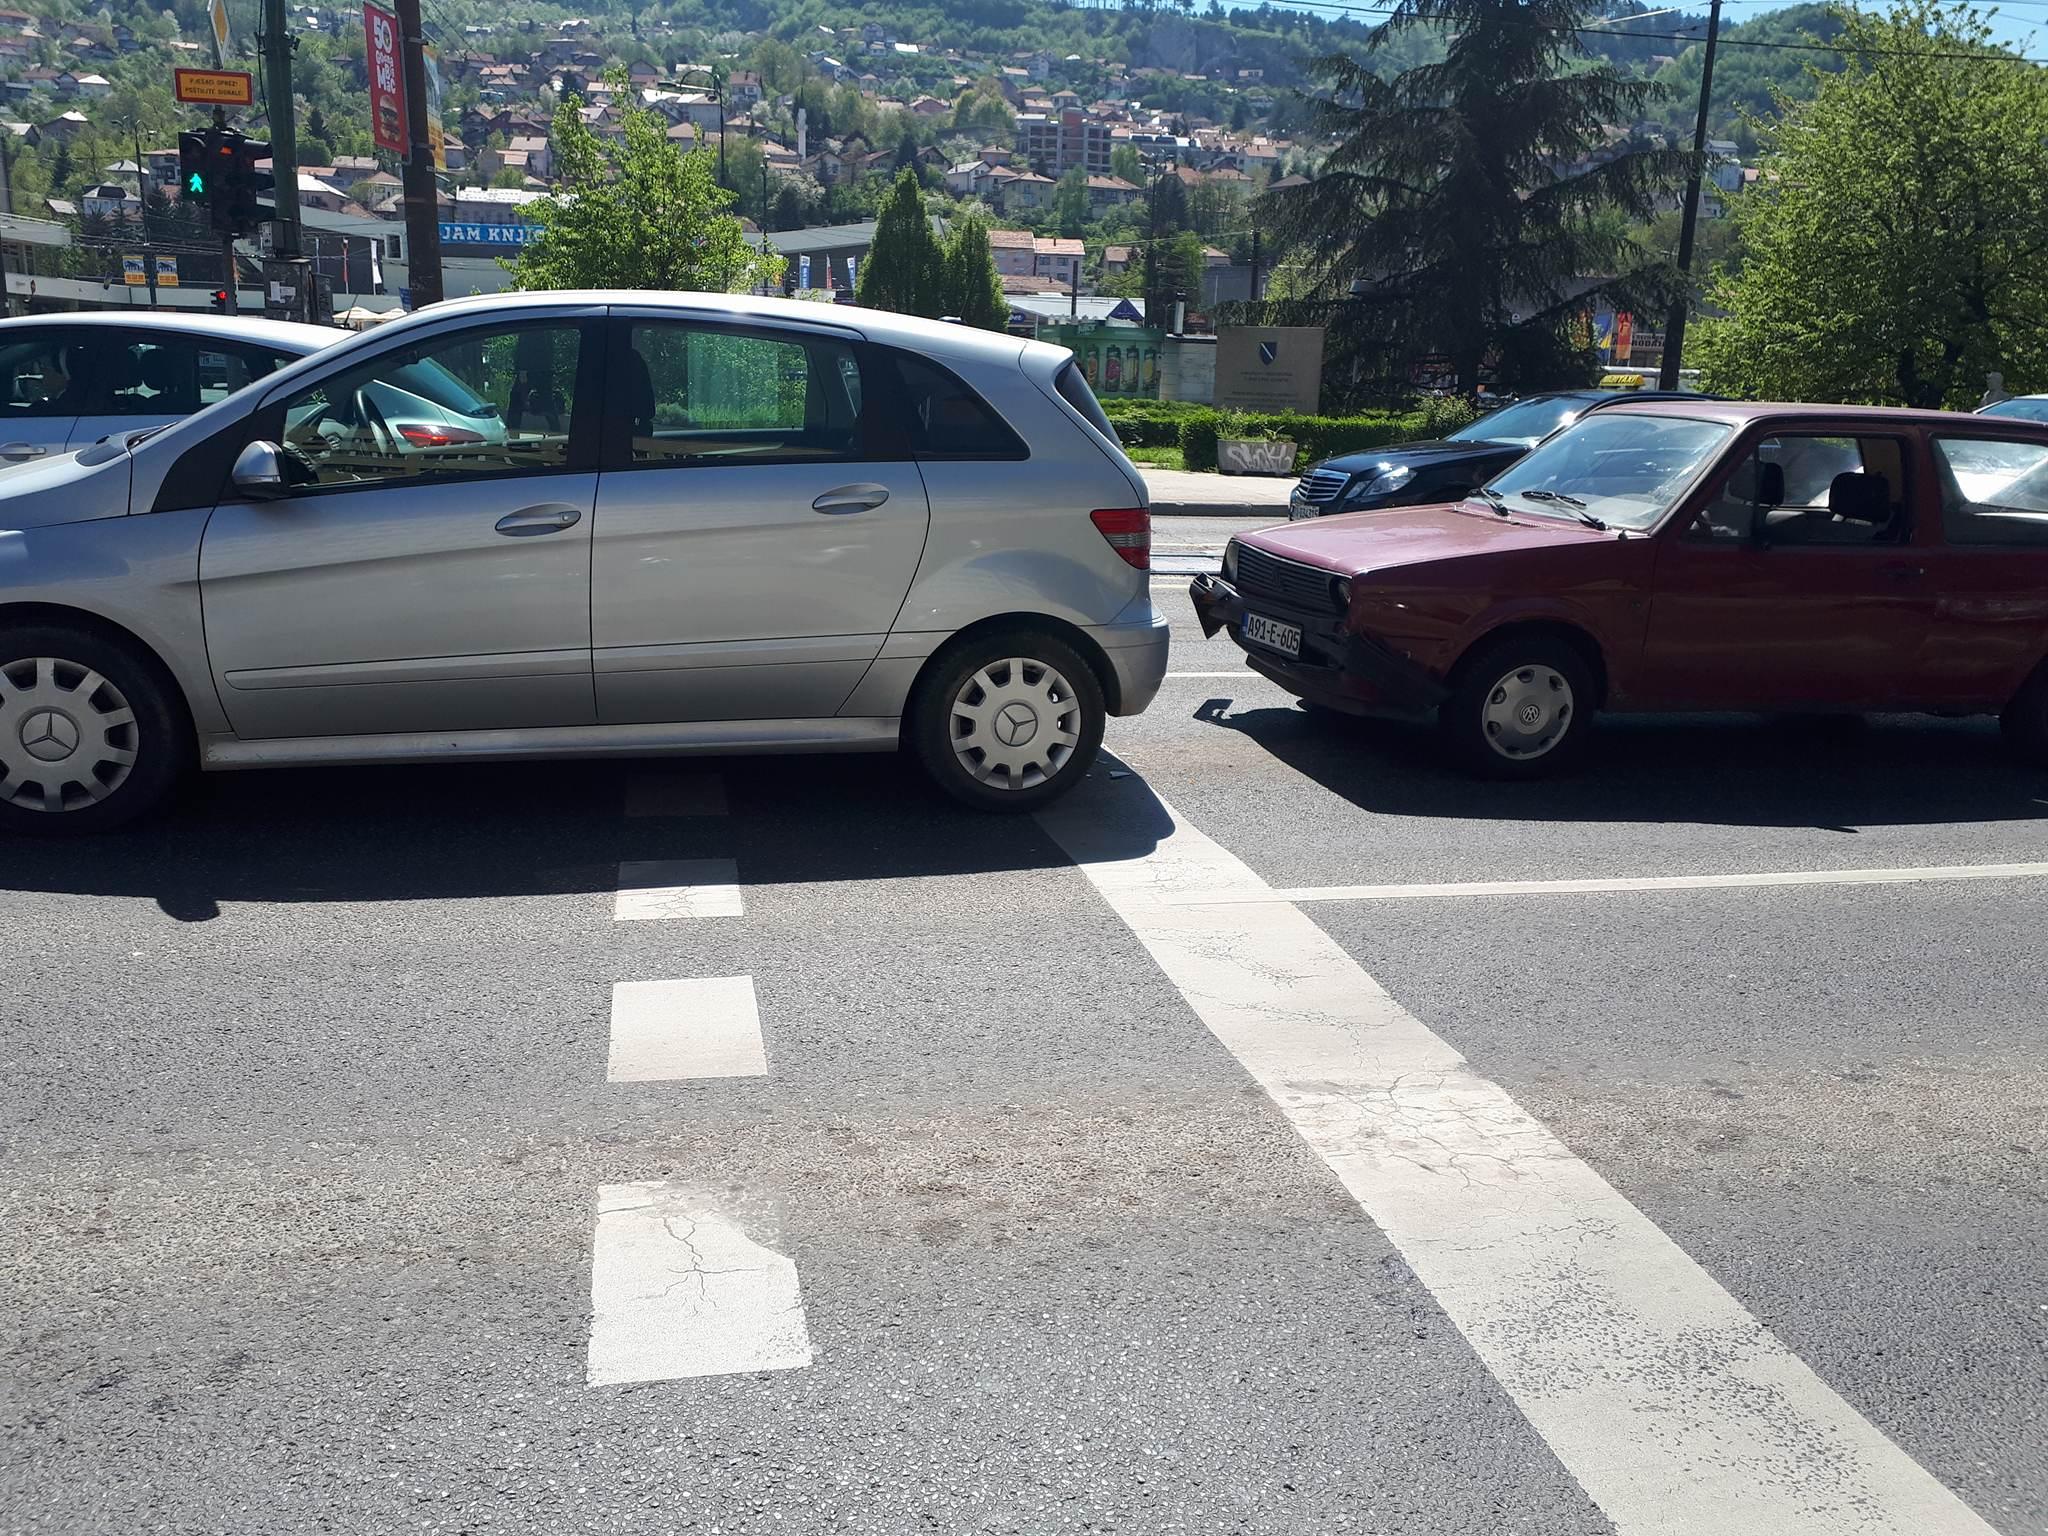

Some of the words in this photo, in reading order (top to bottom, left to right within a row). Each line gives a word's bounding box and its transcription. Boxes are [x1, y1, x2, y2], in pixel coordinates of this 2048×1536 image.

[374, 15, 392, 54] 50
[442, 226, 480, 241] JAM
[1247, 616, 1300, 652] A91-E-605
